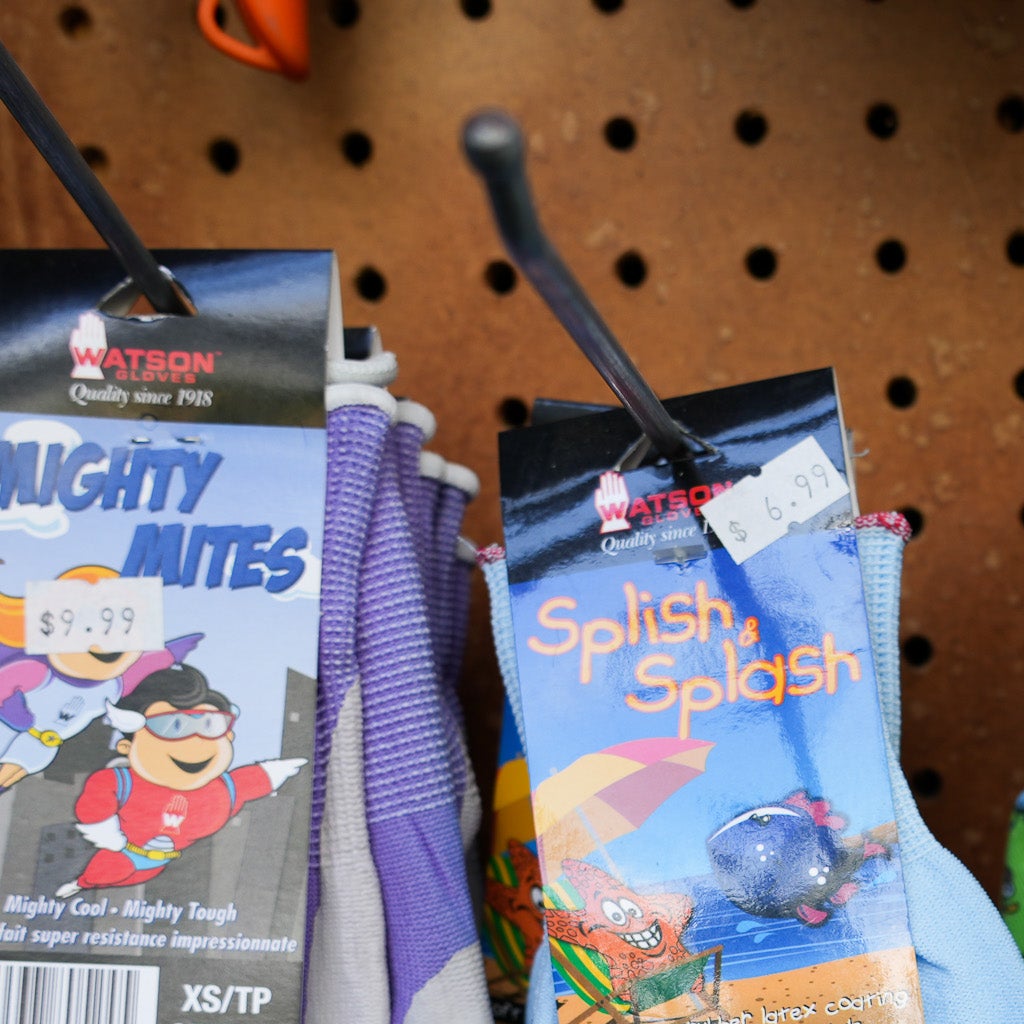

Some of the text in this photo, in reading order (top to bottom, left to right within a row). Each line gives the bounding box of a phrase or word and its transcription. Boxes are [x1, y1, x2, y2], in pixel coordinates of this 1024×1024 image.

[73, 346, 215, 374] WATSON
[115, 369, 197, 384] GLOVES
[69, 382, 214, 408] Quality since 1918
[601, 531, 657, 556] Quality
[661, 525, 698, 543] since
[120, 523, 309, 594] MITES
[40, 606, 136, 637] $9.99
[527, 580, 761, 685] Splish &
[625, 632, 862, 741] Splash
[3, 895, 237, 926] Mighty Cool Mighty Tough
[30, 928, 79, 949] super
[81, 927, 167, 949] resistance
[170, 930, 298, 955] impressionnate
[181, 984, 273, 1015] XS/TP
[826, 989, 909, 1017] coating
